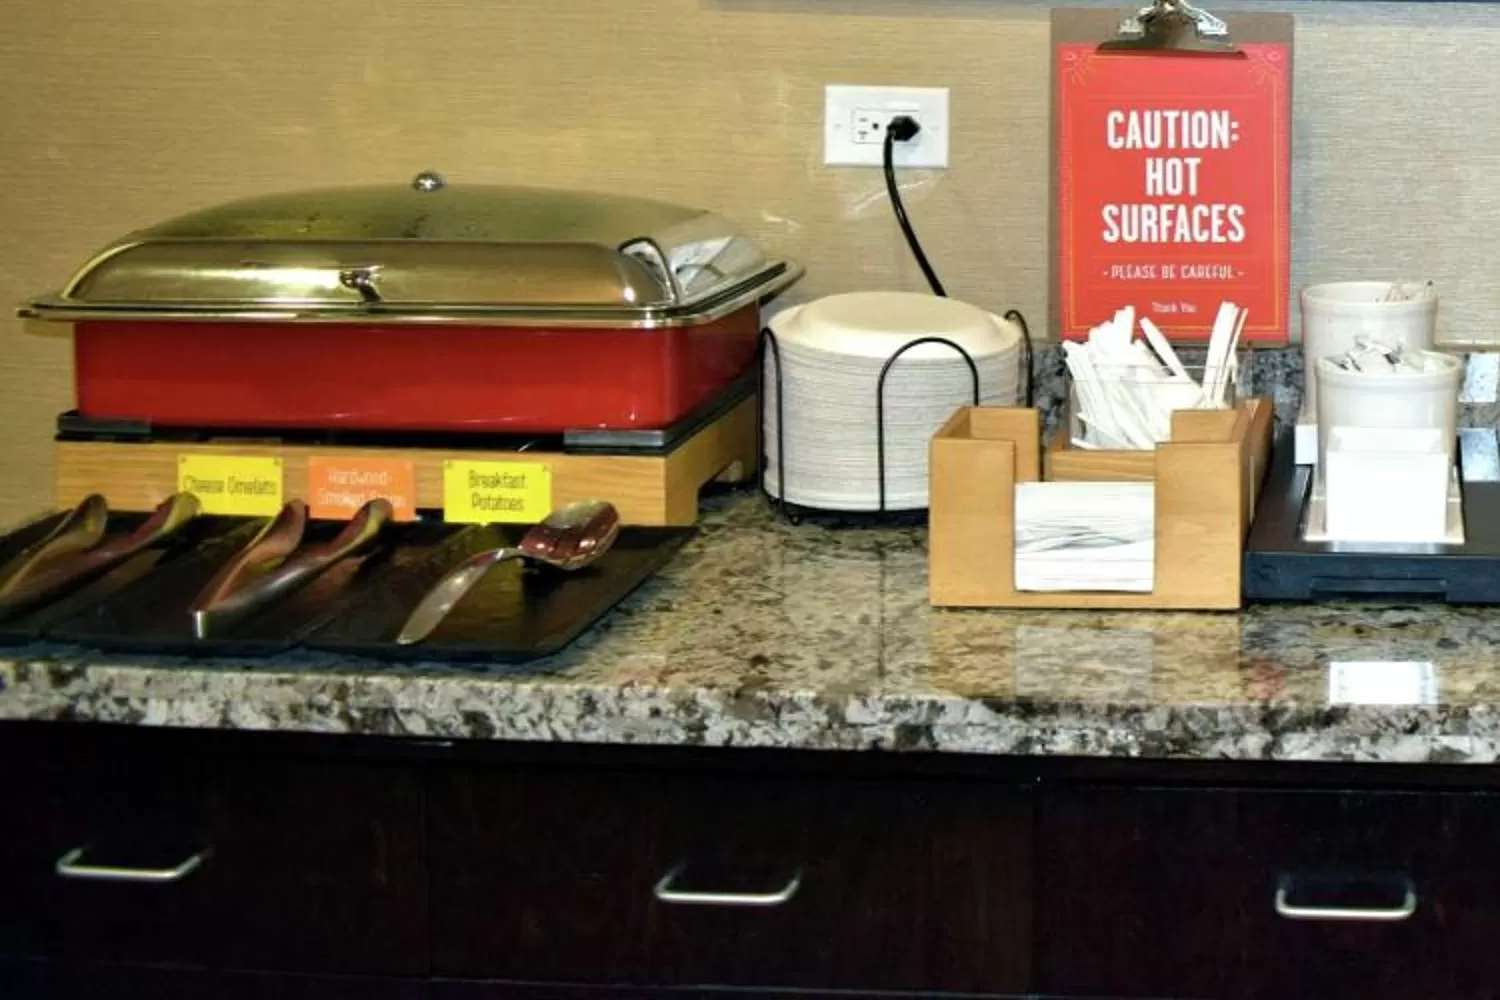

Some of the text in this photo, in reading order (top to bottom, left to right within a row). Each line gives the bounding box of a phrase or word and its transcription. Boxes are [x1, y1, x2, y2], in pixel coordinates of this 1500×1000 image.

[1107, 110, 1240, 149] CAUTION:
[1145, 157, 1202, 196] HOT
[1102, 204, 1246, 243] SURFACES
[1111, 264, 1234, 280] PLEASE BE CAREFUL
[468, 469, 527, 489] Breakfast
[472, 492, 525, 511] Potatoes
